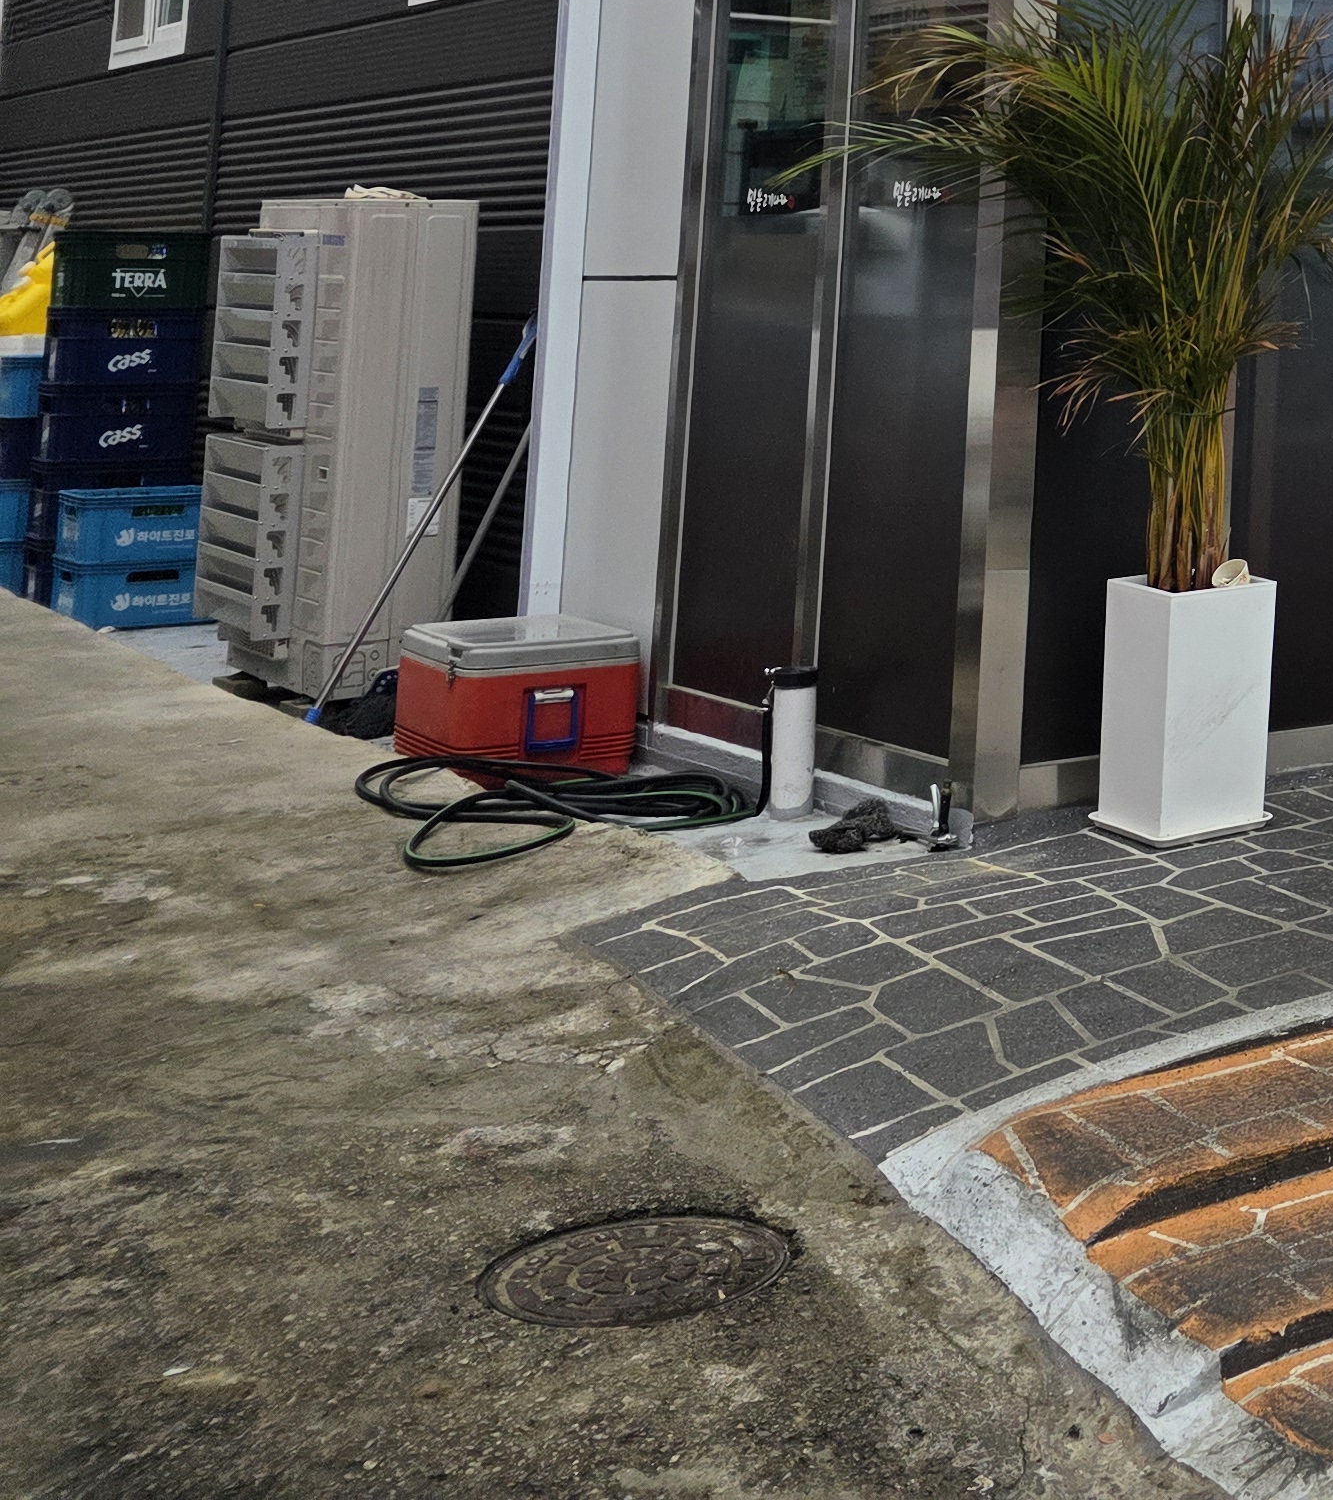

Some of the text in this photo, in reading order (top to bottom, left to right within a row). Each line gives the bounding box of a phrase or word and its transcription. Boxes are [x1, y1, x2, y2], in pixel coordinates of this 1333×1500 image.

[112, 268, 167, 289] TERRA
[136, 528, 195, 542] 하이트진로
[131, 592, 191, 608] 하이트진로
